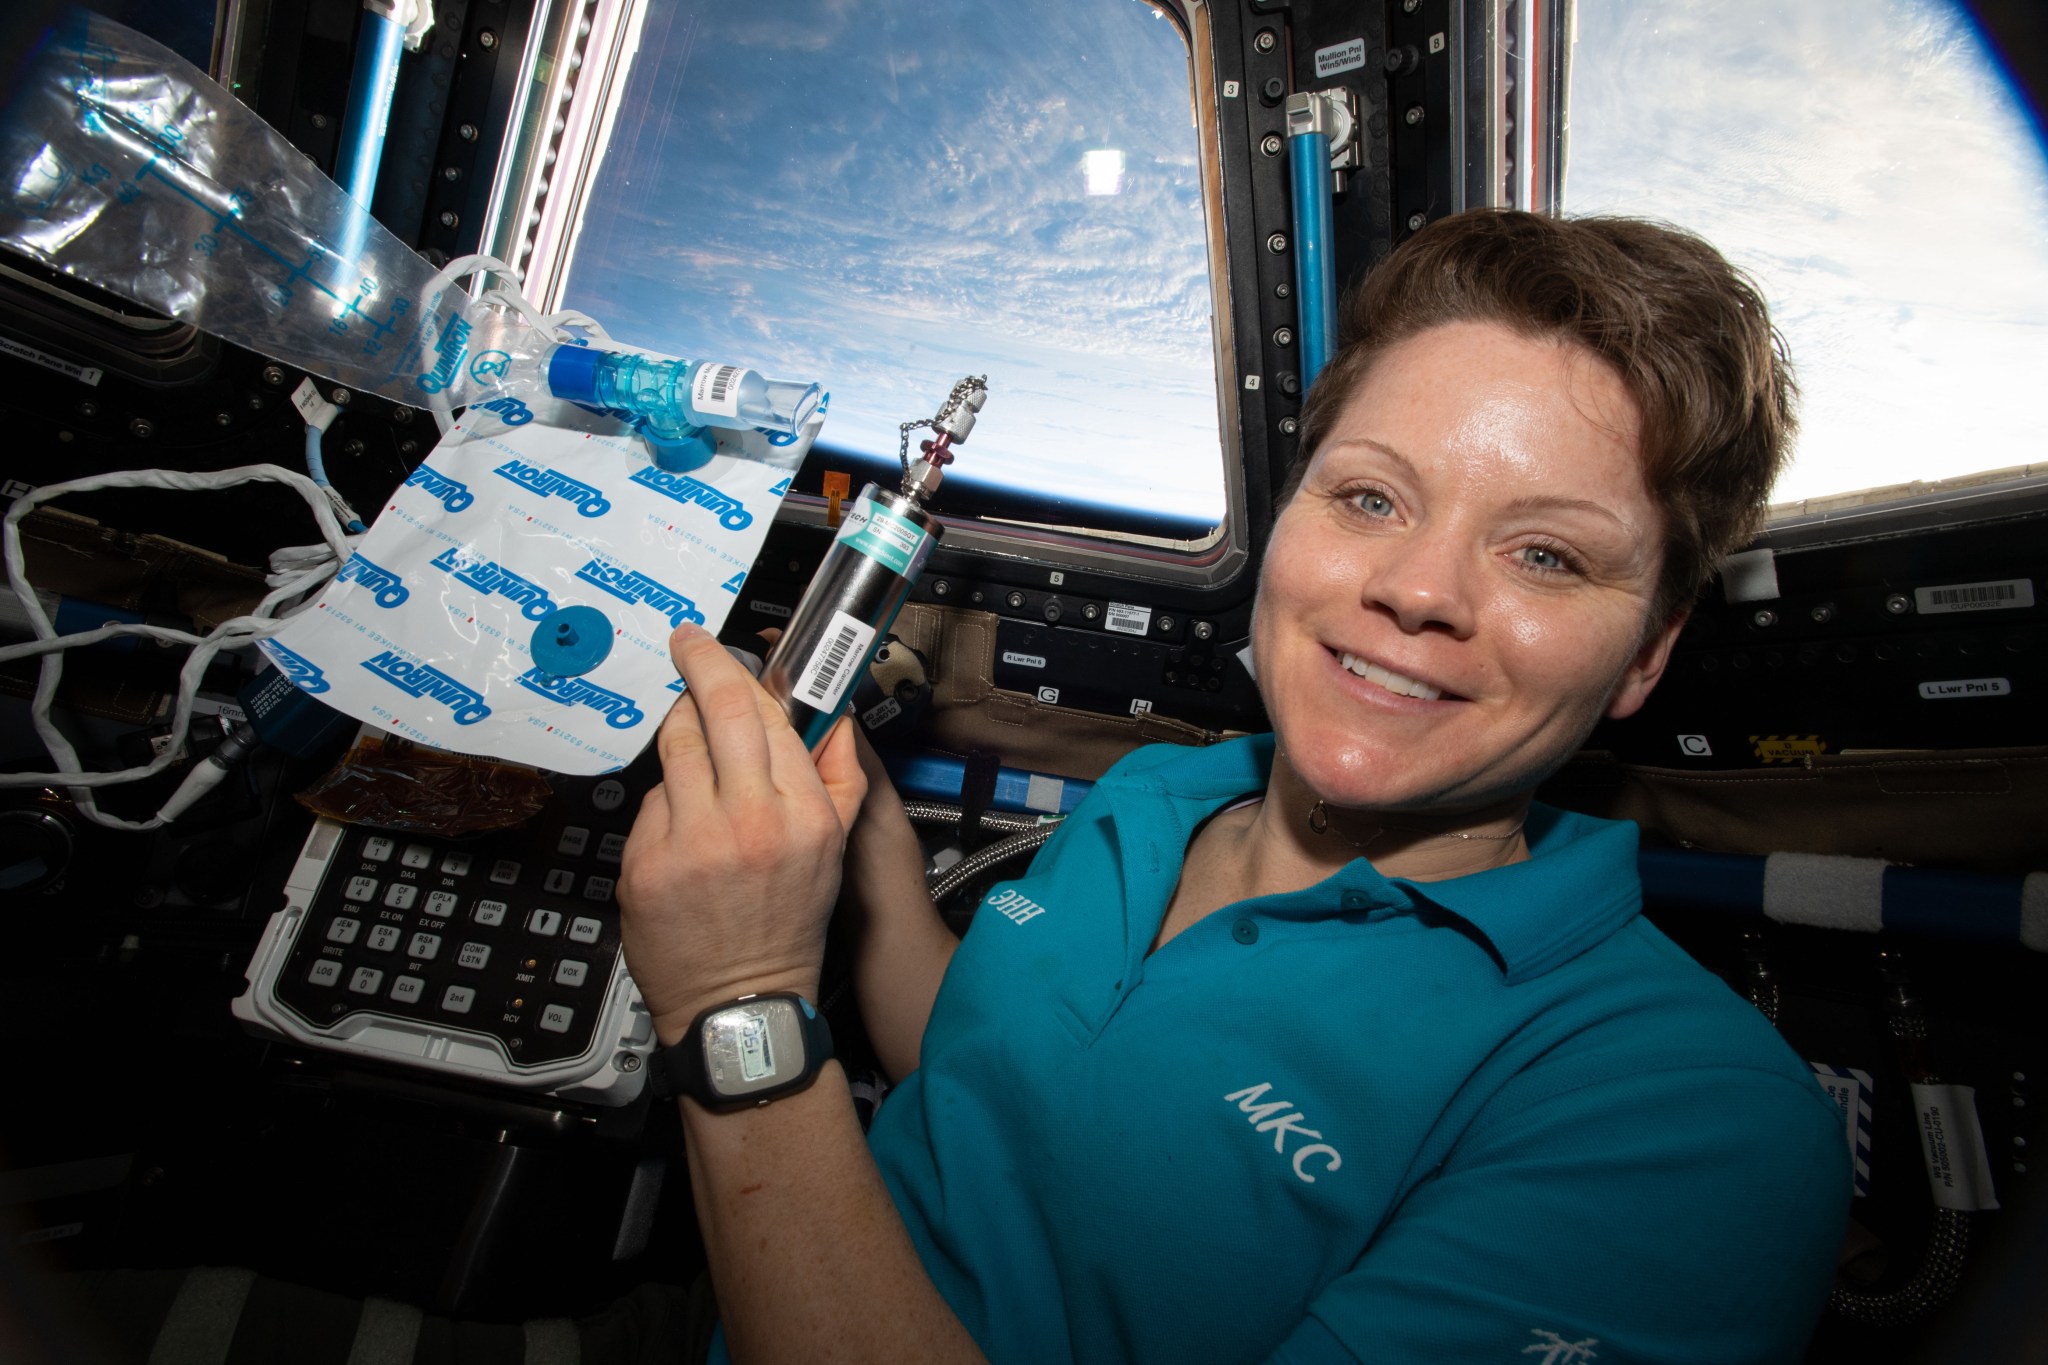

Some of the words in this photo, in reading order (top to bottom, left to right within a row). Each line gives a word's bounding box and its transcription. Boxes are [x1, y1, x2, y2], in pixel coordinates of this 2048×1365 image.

[1433, 38, 1440, 49] 8
[1318, 48, 1347, 63] Mullion
[1348, 44, 1362, 55] Pnl
[1320, 54, 1361, 71] Win5/Win6
[1227, 84, 1235, 95] 3
[360, 276, 378, 297] 40
[390, 297, 411, 316] 30
[328, 317, 349, 336] 16
[363, 336, 383, 357] 12
[1249, 378, 1255, 387] 4
[508, 504, 528, 518] USA
[648, 512, 667, 528] USA
[1053, 574, 1060, 583] 5
[848, 643, 864, 669] Marrow
[1013, 655, 1025, 663] Lwr
[1026, 657, 1037, 665] Pnl
[832, 665, 851, 696] Canister
[1926, 686, 1936, 694] L
[1938, 685, 1962, 694] Lwr
[1966, 683, 1988, 692] Pnl
[1991, 682, 2000, 691] 5
[1040, 688, 1057, 701] G
[371, 704, 393, 721] USA
[527, 715, 548, 729] USA
[1683, 736, 1707, 753] C
[596, 787, 620, 801] PTT
[372, 838, 389, 848] HAB
[411, 855, 419, 864] 2
[361, 863, 377, 872] DAG
[450, 862, 457, 872] 3
[400, 870, 416, 880] DAA
[355, 878, 371, 888] LAB
[441, 878, 455, 887] DIA
[398, 886, 409, 895] CF
[395, 896, 402, 906] 5
[432, 892, 453, 903] CPLA
[342, 903, 360, 913] EMU
[435, 903, 442, 913] 6
[480, 901, 502, 912] HANG
[379, 910, 391, 920] EX
[391, 912, 405, 922] ON
[482, 912, 494, 921] UP
[335, 919, 354, 929] JEM
[418, 918, 430, 927] EX
[430, 920, 447, 930] OFF
[575, 924, 594, 935] MON
[336, 929, 345, 939] 7
[377, 927, 393, 937] ESA
[377, 937, 385, 947] 8
[417, 935, 434, 945] RSA
[322, 945, 345, 957] BRITE
[418, 945, 426, 955] 9
[464, 944, 487, 954] CONF
[461, 954, 481, 965] LSTN
[316, 966, 334, 977] LOG
[408, 962, 422, 972] BIT
[562, 966, 579, 977] VOX
[360, 969, 375, 979] PIN
[515, 972, 536, 983] XMIT
[398, 982, 416, 993] CLR
[449, 992, 465, 1003] 2nd
[502, 1013, 520, 1024] RCV
[547, 1011, 563, 1024] VOL
[1923, 1112, 1933, 1130] Line
[1926, 1130, 1940, 1165] Vacuum
